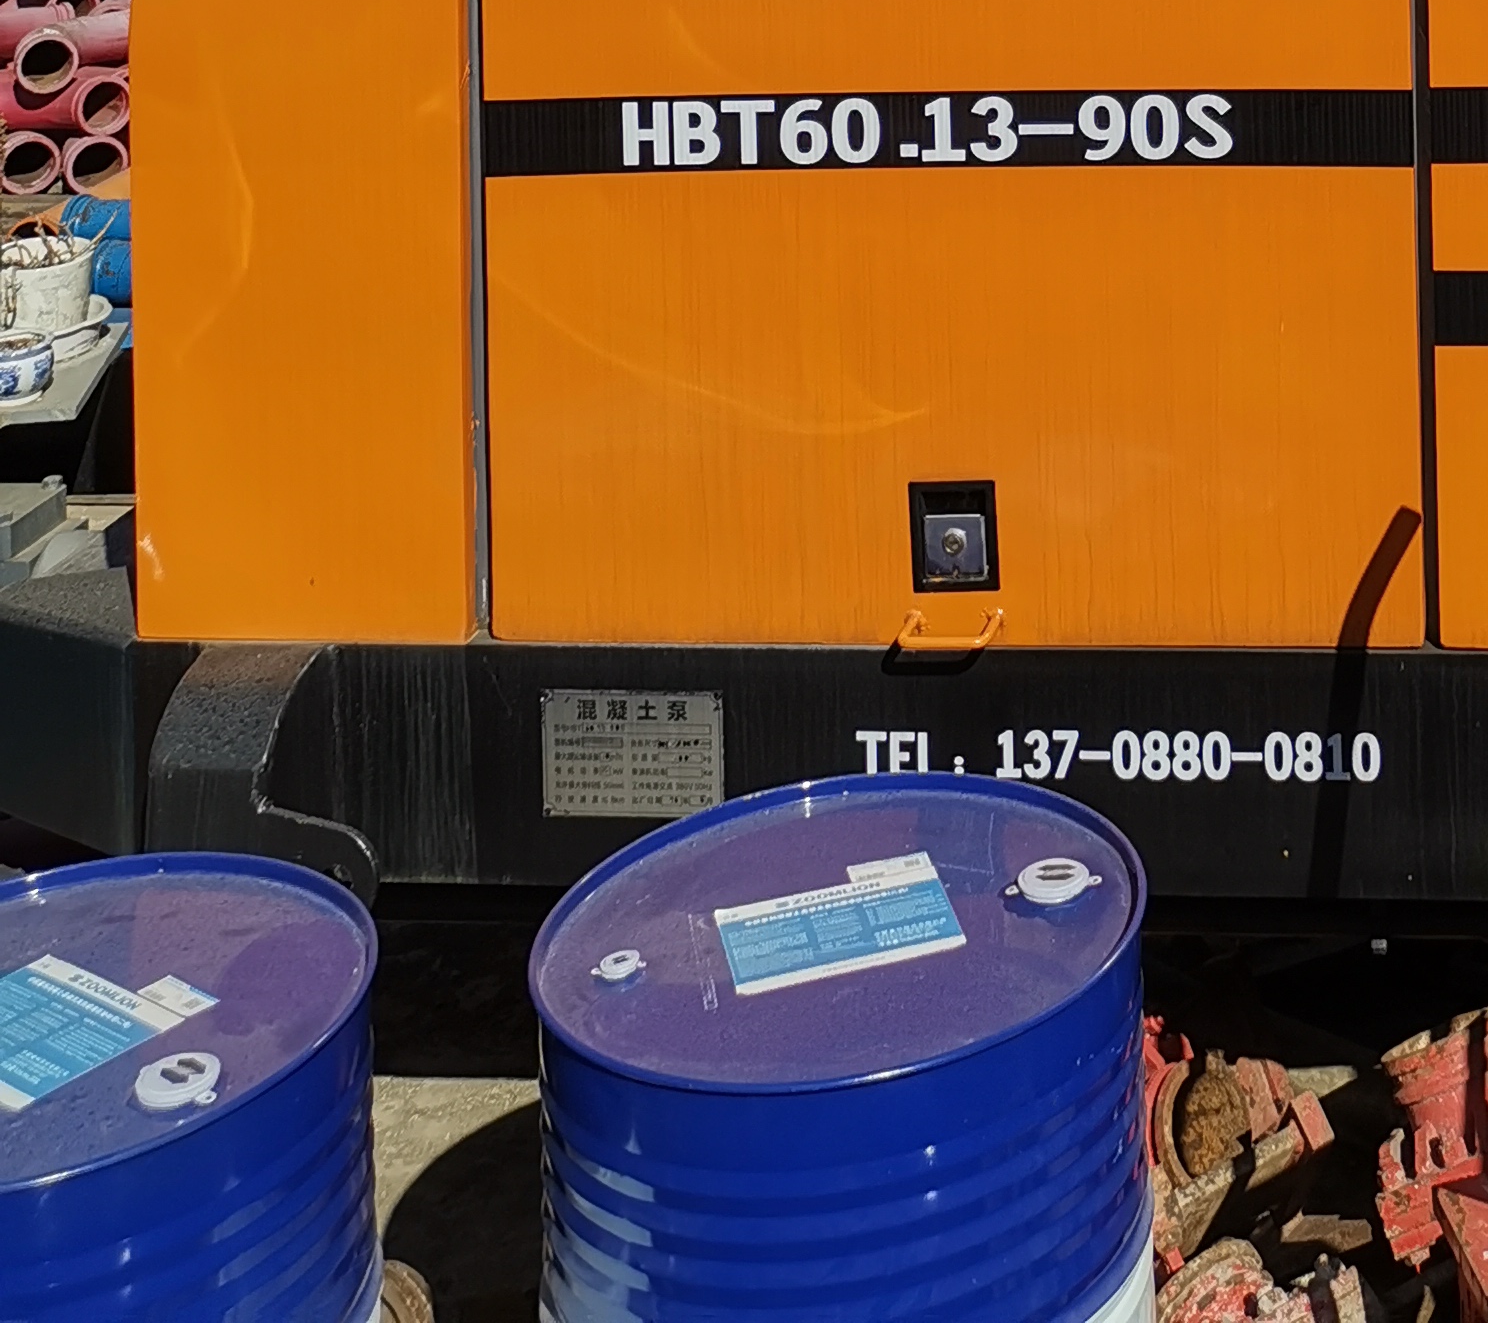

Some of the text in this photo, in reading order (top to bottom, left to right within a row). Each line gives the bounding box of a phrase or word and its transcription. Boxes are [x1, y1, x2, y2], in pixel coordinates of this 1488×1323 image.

[622, 93, 1234, 168] HBT60.13-90S
[577, 699, 687, 721] 混凝土泵
[997, 729, 1381, 781] 137-0880-0810
[792, 881, 881, 905] ZOOMLION
[79, 976, 142, 1011] ZOOMLION
